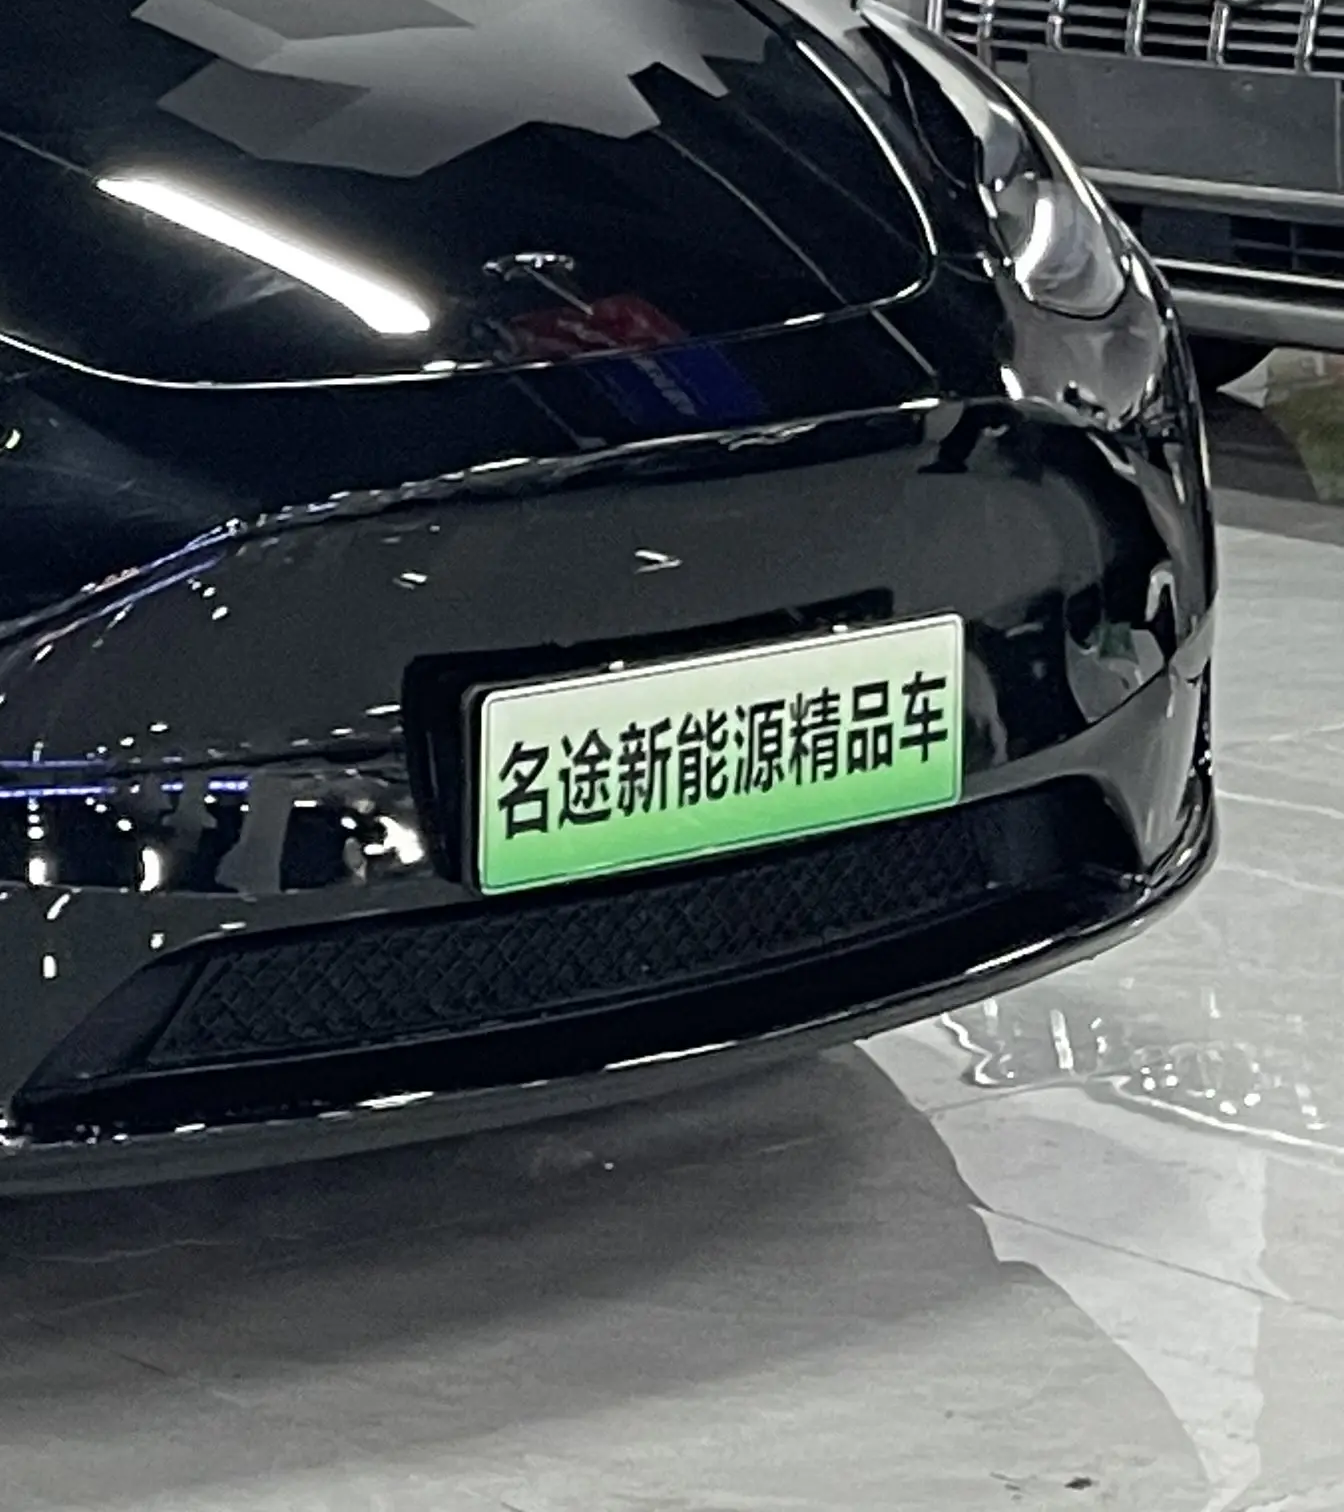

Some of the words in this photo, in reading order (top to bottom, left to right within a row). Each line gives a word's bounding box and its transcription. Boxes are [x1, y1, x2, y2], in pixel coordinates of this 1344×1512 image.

[498, 672, 948, 840] 名途新能源精品车
